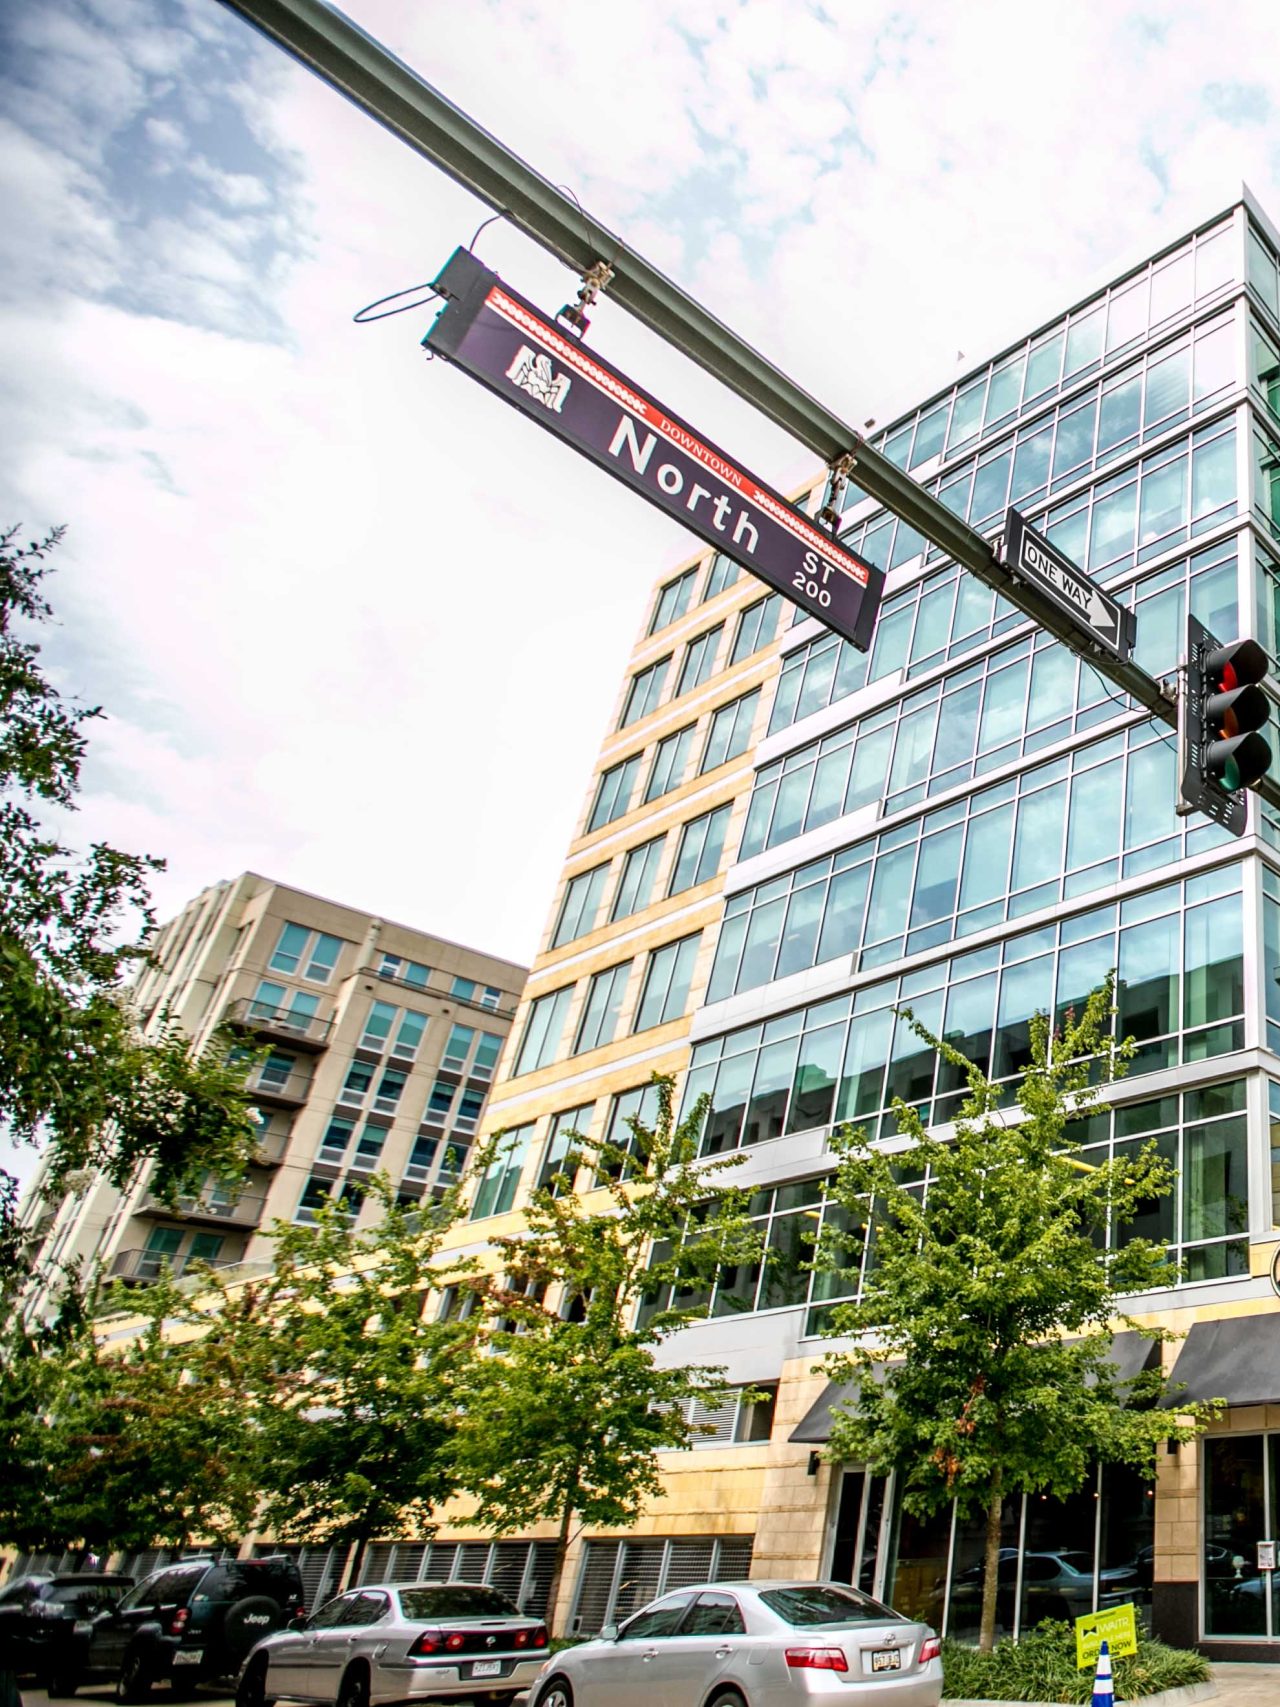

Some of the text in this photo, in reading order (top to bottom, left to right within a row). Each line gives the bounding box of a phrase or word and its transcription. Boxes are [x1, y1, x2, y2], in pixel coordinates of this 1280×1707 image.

[660, 419, 742, 487] DOWNTOWN
[608, 414, 759, 554] North
[803, 551, 835, 584] ST
[1028, 546, 1092, 609] ONE WAY
[792, 571, 831, 607] 200
[244, 1613, 271, 1625] Jeep
[1111, 1640, 1132, 1651] NOW
